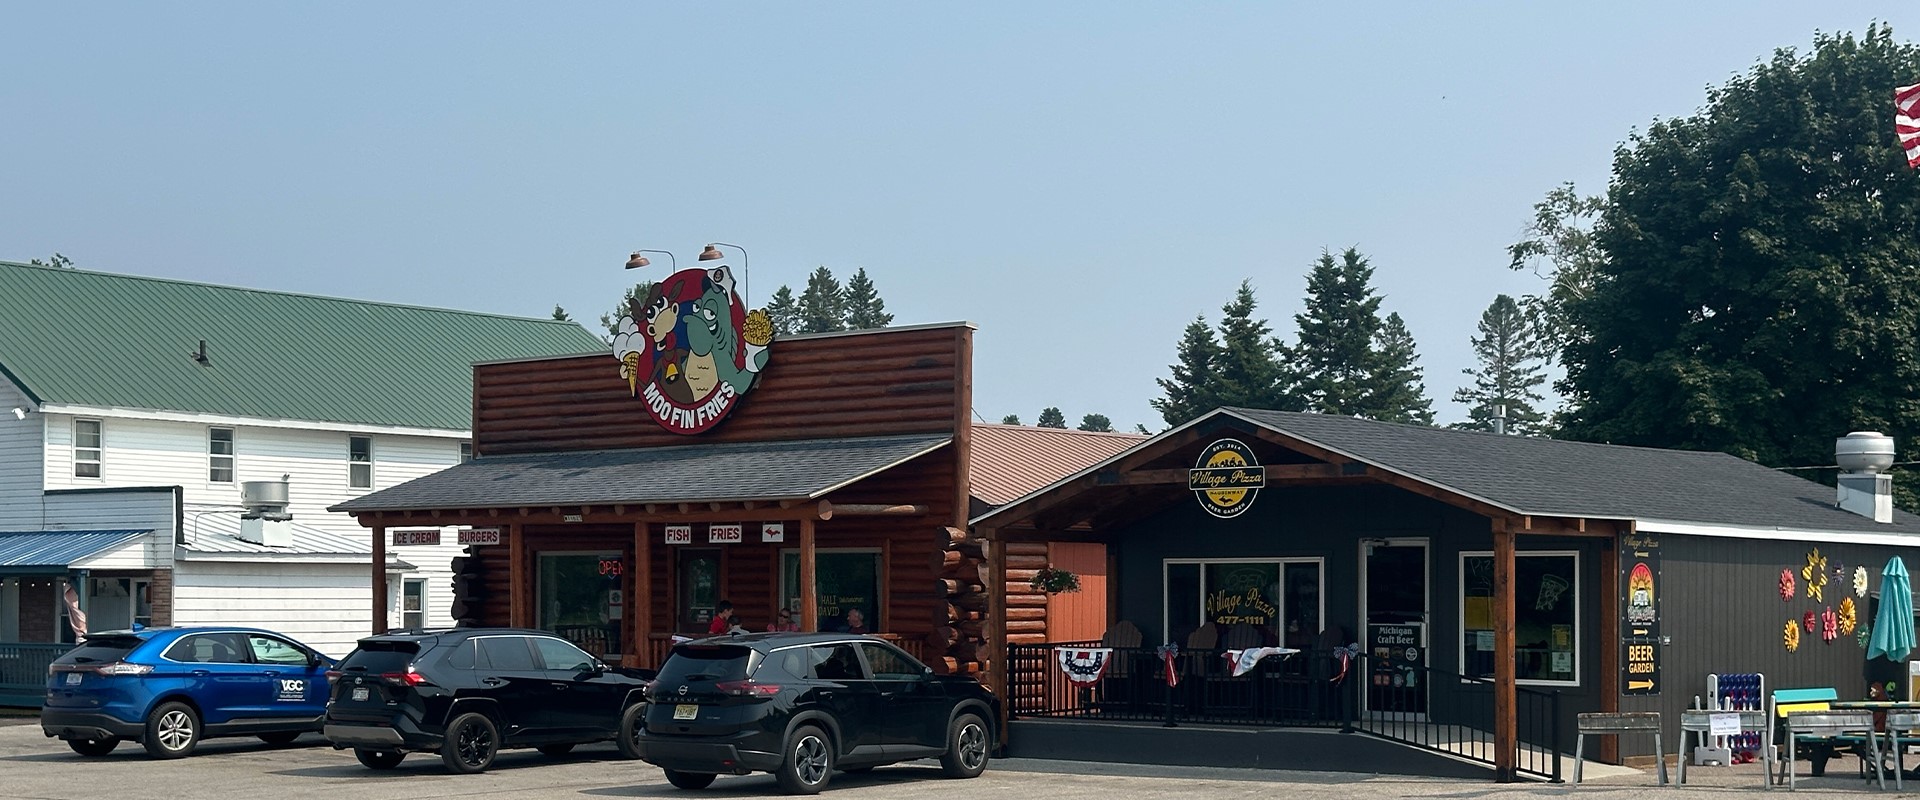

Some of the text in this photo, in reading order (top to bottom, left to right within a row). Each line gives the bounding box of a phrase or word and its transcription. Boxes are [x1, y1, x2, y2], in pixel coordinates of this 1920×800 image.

[643, 381, 735, 428] MOO FIN FRIES
[1191, 469, 1262, 487] Village Pizza
[1208, 502, 1245, 514] BEER GARDEN
[394, 531, 439, 544] ICE CREAM
[458, 530, 498, 543] BURGERS
[666, 529, 690, 541] FISH
[710, 527, 740, 540] FRIES
[1206, 587, 1276, 618] Village Pizza
[818, 606, 840, 617] DAVID
[1216, 615, 1265, 625] 477-1111
[1378, 626, 1413, 636] Michigan
[1377, 635, 1415, 645] Craft Beer
[1628, 645, 1655, 662] BEER
[1628, 662, 1655, 674] GARDEN
